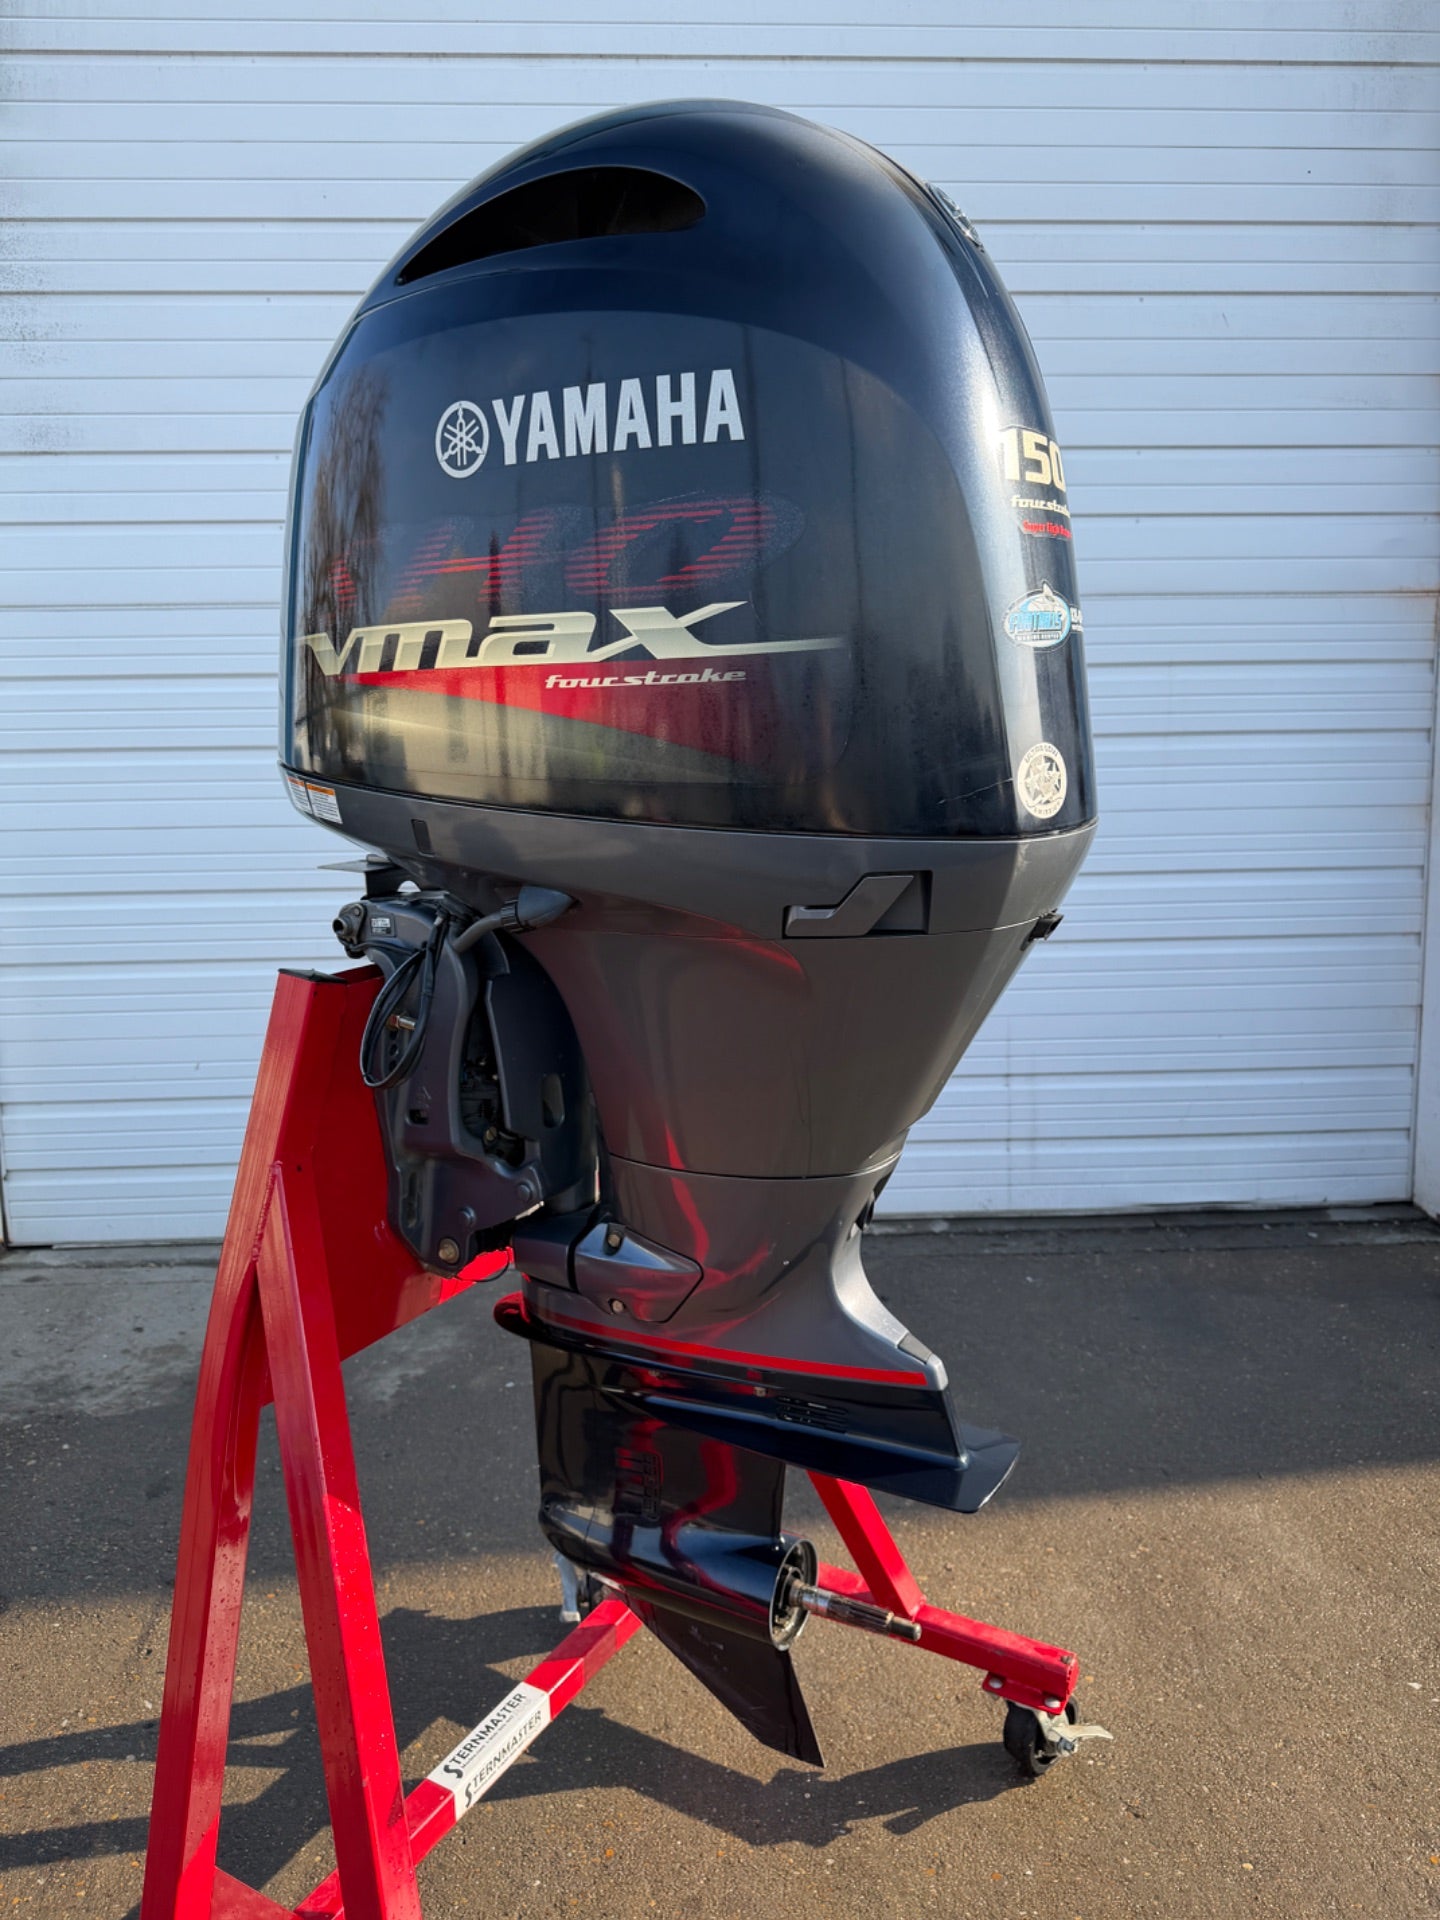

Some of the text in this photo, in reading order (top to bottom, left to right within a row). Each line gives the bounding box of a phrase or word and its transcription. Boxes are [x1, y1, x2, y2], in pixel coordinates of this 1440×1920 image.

[491, 368, 746, 466] YAMAHA
[1002, 427, 1067, 492] 150
[544, 668, 747, 689] four stroke
[443, 1692, 527, 1779] STERNMASTER
[464, 1710, 542, 1809] STERNMASTER
